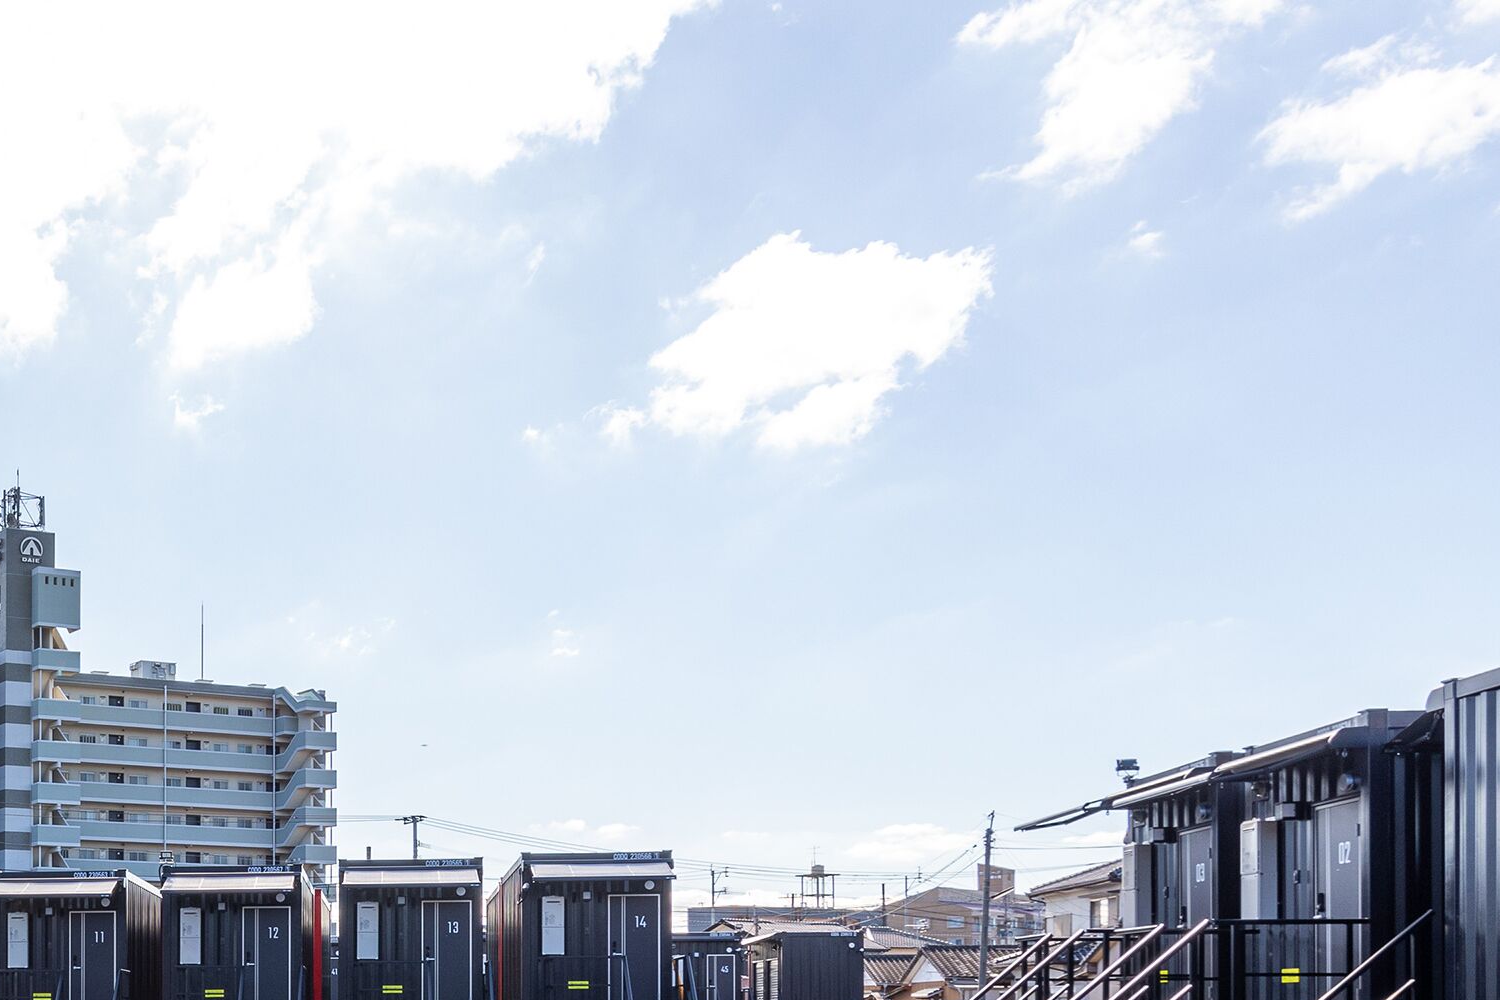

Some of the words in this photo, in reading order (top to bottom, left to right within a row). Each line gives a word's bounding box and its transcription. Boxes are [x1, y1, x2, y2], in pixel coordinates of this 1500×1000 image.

[1338, 841, 1351, 865] 02
[448, 921, 459, 934] 13
[635, 916, 647, 928] 14
[94, 931, 104, 943] 11
[268, 926, 279, 939] 12
[720, 965, 729, 974] 45
